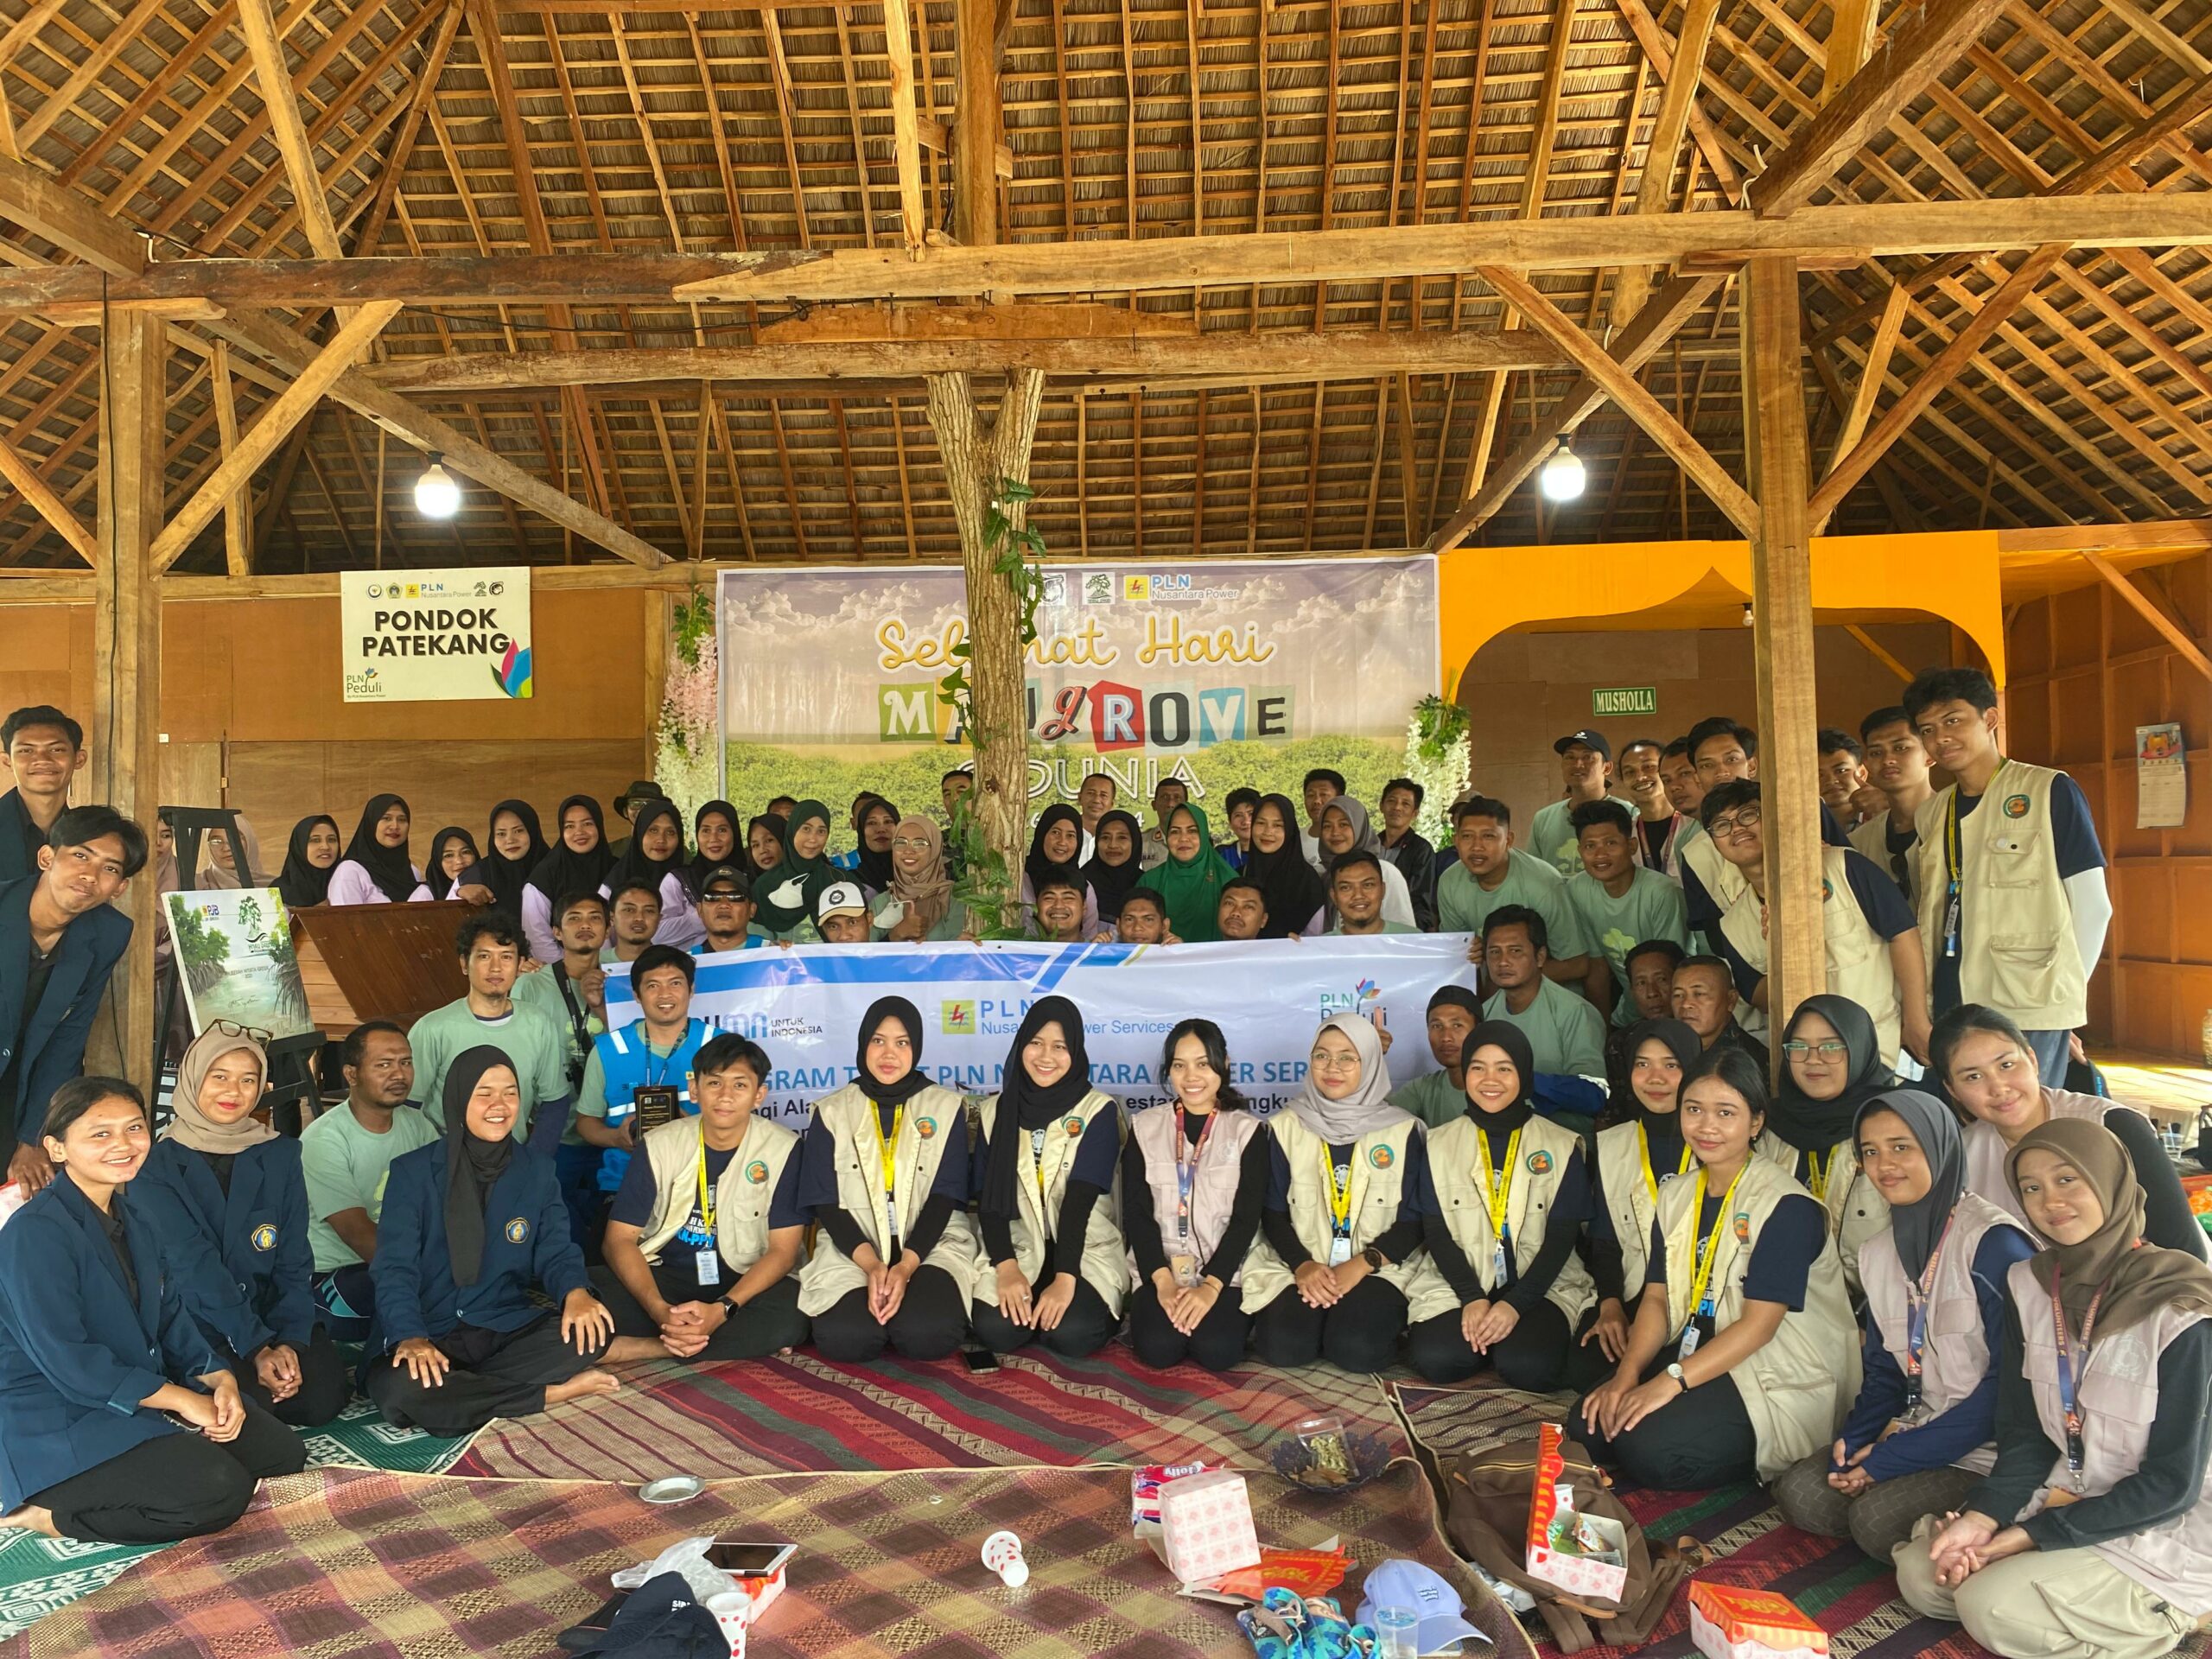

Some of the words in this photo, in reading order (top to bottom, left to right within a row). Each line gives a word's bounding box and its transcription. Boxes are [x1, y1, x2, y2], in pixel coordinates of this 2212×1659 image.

[1152, 576, 1190, 588] PLN
[1153, 590, 1204, 600] Nusantara
[1206, 589, 1238, 598] Power
[375, 608, 499, 632] PONDOK
[362, 633, 510, 657] PATEKANG
[879, 618, 1117, 670] Selat
[1139, 615, 1274, 664] Hari
[346, 682, 381, 692] Peduli
[1596, 690, 1653, 712] MUSHOLLA
[981, 999, 1034, 1018] PLN
[1320, 993, 1353, 1008] PLN
[771, 1017, 804, 1027] UNTUK
[771, 1026, 823, 1037] INDONESIA
[1111, 1018, 1174, 1034] Services
[938, 1065, 984, 1085] PLN
[2053, 1297, 2065, 1346] VOLUNTEERS
[2082, 1294, 2101, 1341] VOLUNTEERS
